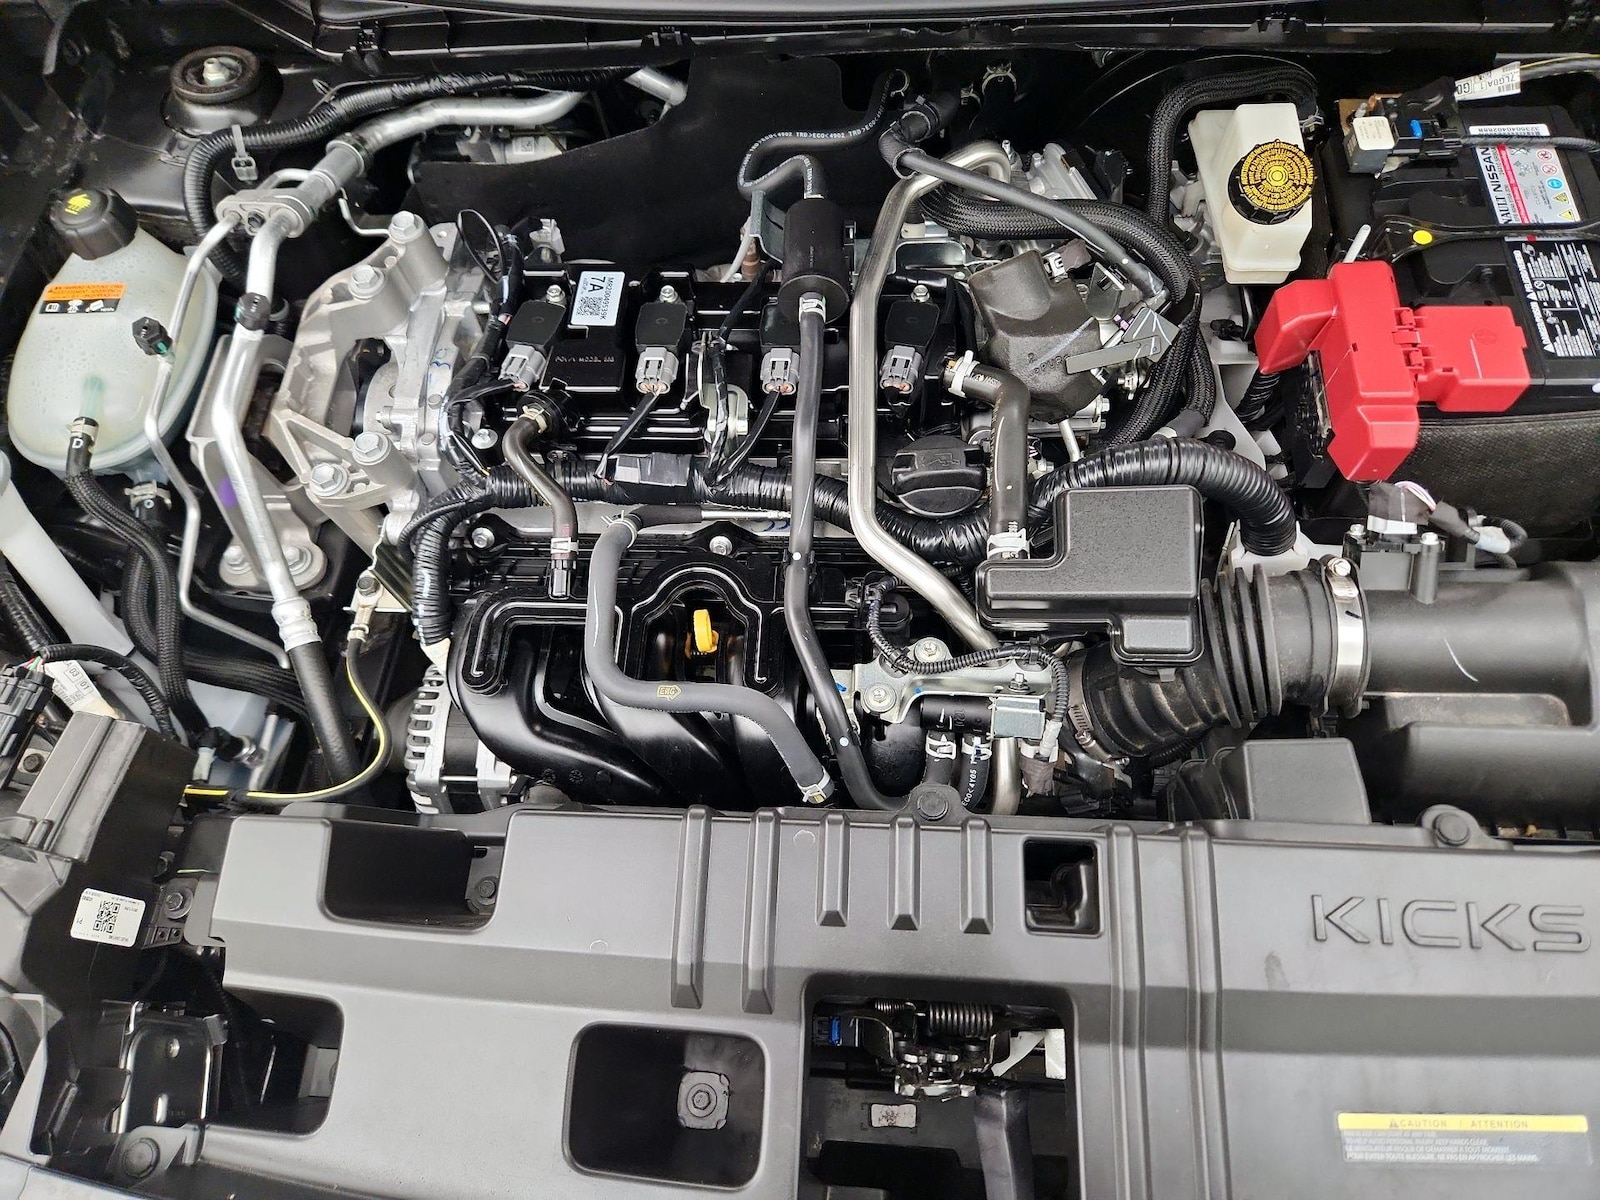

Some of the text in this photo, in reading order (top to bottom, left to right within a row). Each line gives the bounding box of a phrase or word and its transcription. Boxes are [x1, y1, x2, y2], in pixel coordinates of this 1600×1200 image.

[1480, 146, 1503, 194] NISSAN
[588, 276, 606, 293] 7A
[72, 438, 84, 449] D
[1311, 894, 1592, 953] KICKS
[1400, 1119, 1447, 1128] CAUTION
[1471, 1120, 1528, 1129] ATTENTION
